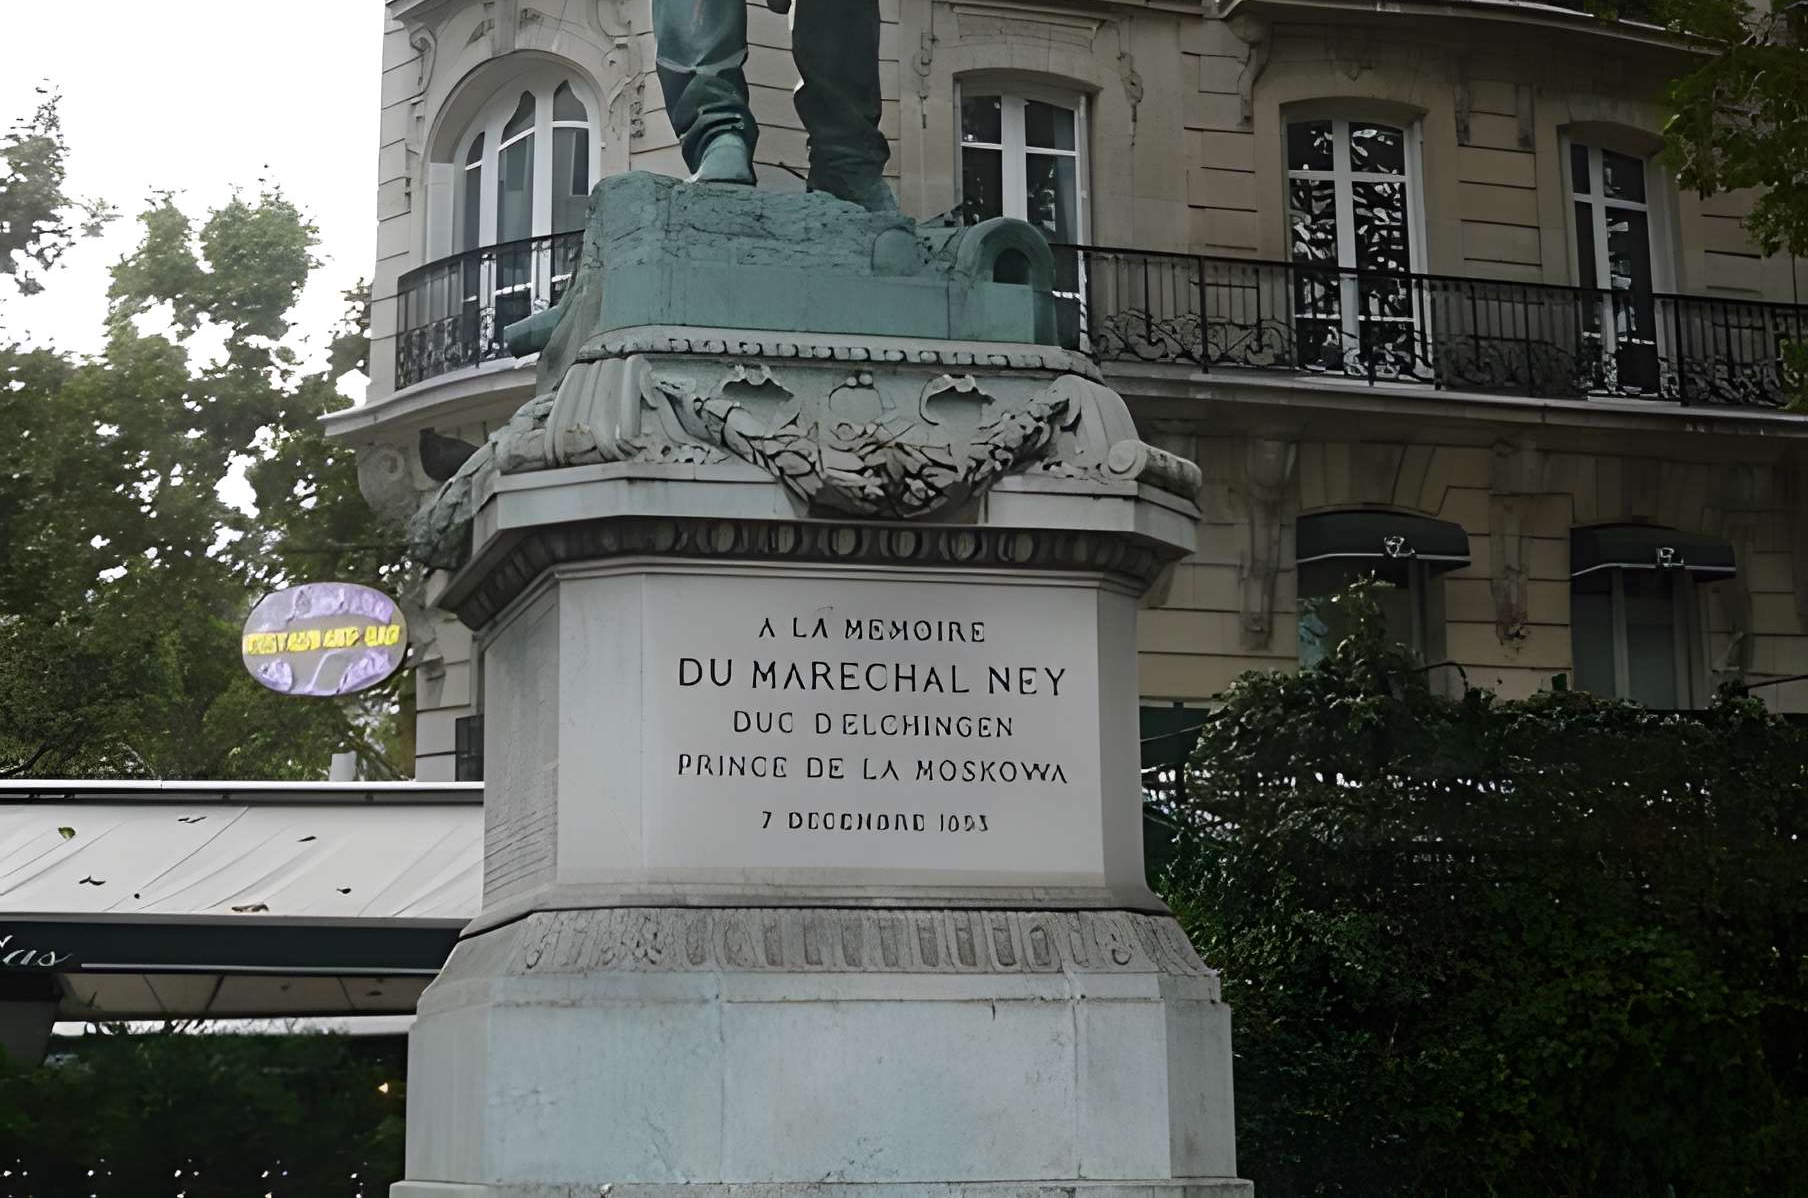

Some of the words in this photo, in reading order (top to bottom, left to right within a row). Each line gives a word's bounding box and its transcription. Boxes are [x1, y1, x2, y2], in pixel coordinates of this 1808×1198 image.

[758, 617, 776, 639] A
[792, 616, 829, 639] LA
[844, 618, 985, 643] MEMOIRE
[678, 657, 733, 688] DU
[751, 659, 971, 694] MARECHAL
[988, 665, 1066, 697] NEY
[733, 710, 793, 734] DUC
[677, 753, 788, 779] PRINCE
[806, 756, 845, 780] DE
[863, 757, 900, 782] LA
[915, 759, 1068, 785] MOSKOWA
